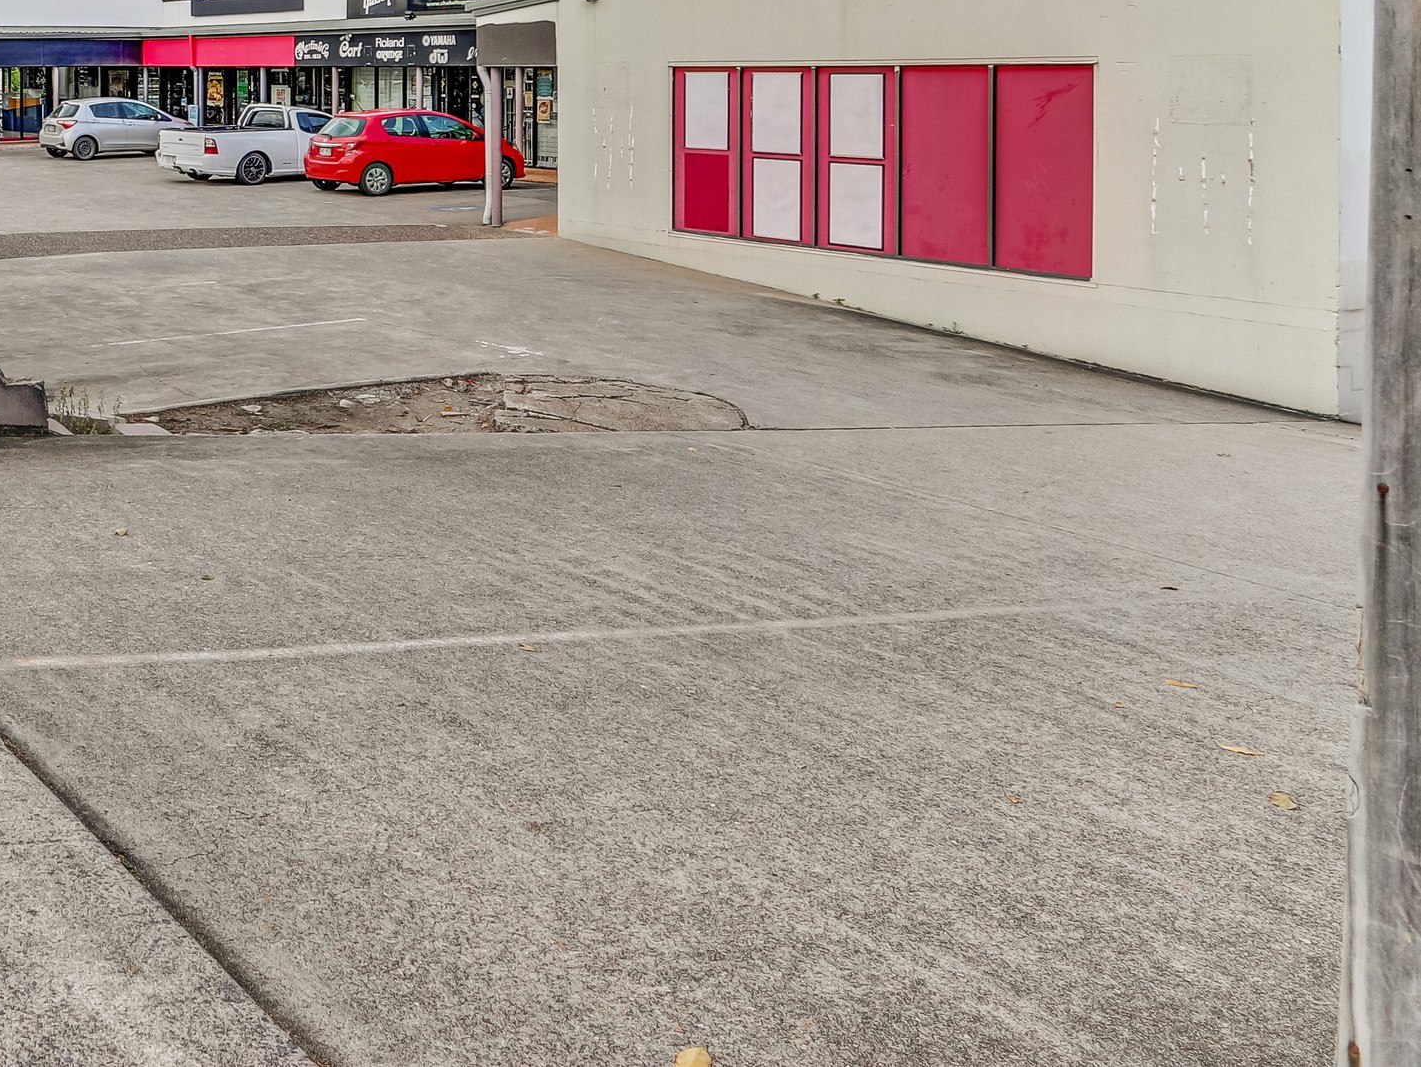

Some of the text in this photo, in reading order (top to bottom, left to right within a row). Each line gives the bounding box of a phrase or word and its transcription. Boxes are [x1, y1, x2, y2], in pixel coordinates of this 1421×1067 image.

[375, 37, 405, 48] Roland
[430, 35, 456, 45] YAMAHA
[339, 41, 363, 58] Cort
